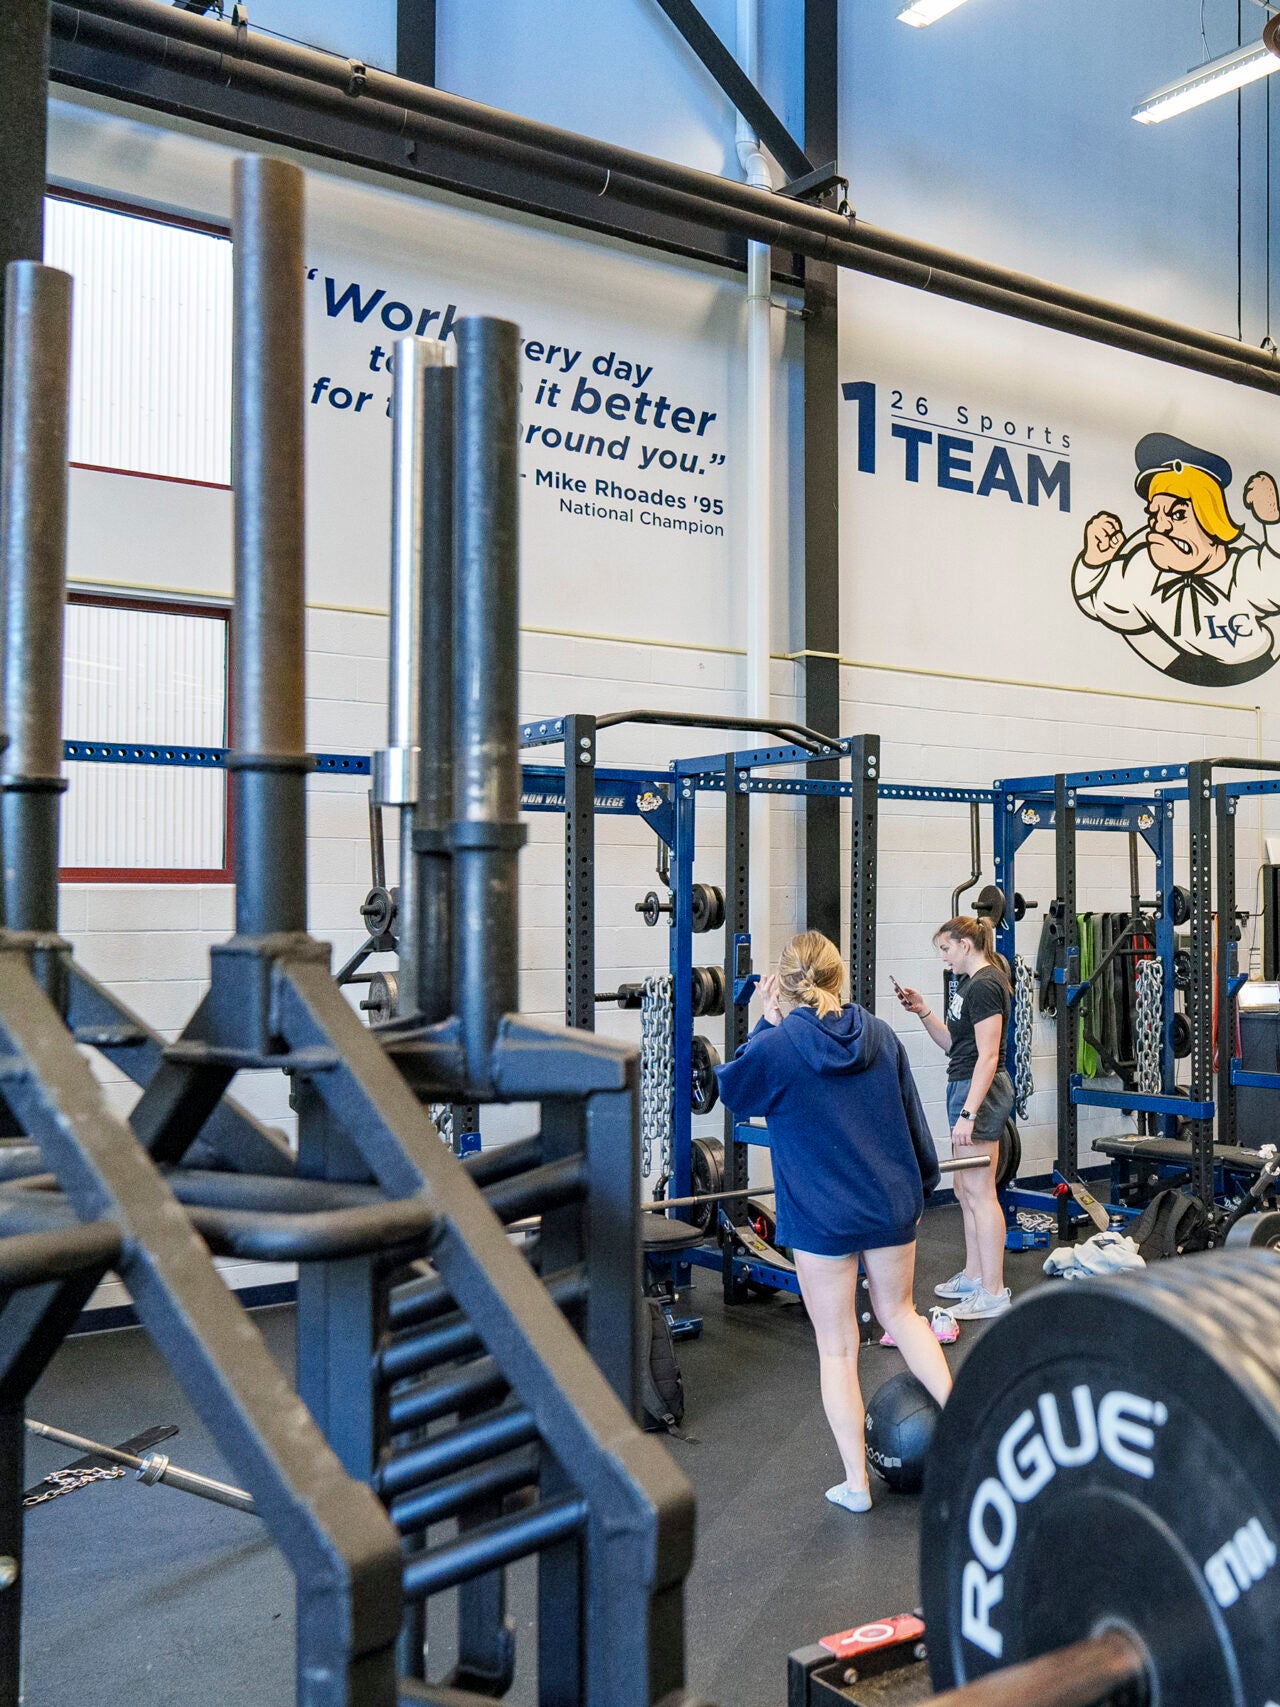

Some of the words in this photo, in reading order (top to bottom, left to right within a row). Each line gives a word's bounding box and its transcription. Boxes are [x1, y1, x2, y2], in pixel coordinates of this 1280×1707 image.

[520, 338, 582, 373] ery
[591, 351, 654, 389] day
[310, 376, 374, 412] for
[519, 422, 631, 461] round
[535, 378, 561, 408] it
[570, 376, 717, 437] better
[890, 390, 929, 416] 26
[956, 405, 1071, 449] Sports
[841, 381, 876, 475] 1
[891, 422, 1071, 514] TEAM
[535, 469, 587, 493] Mike
[595, 479, 686, 509] Rhoades
[560, 498, 634, 523] National
[640, 511, 724, 537] Champion
[961, 1384, 1161, 1659] ROGUE
